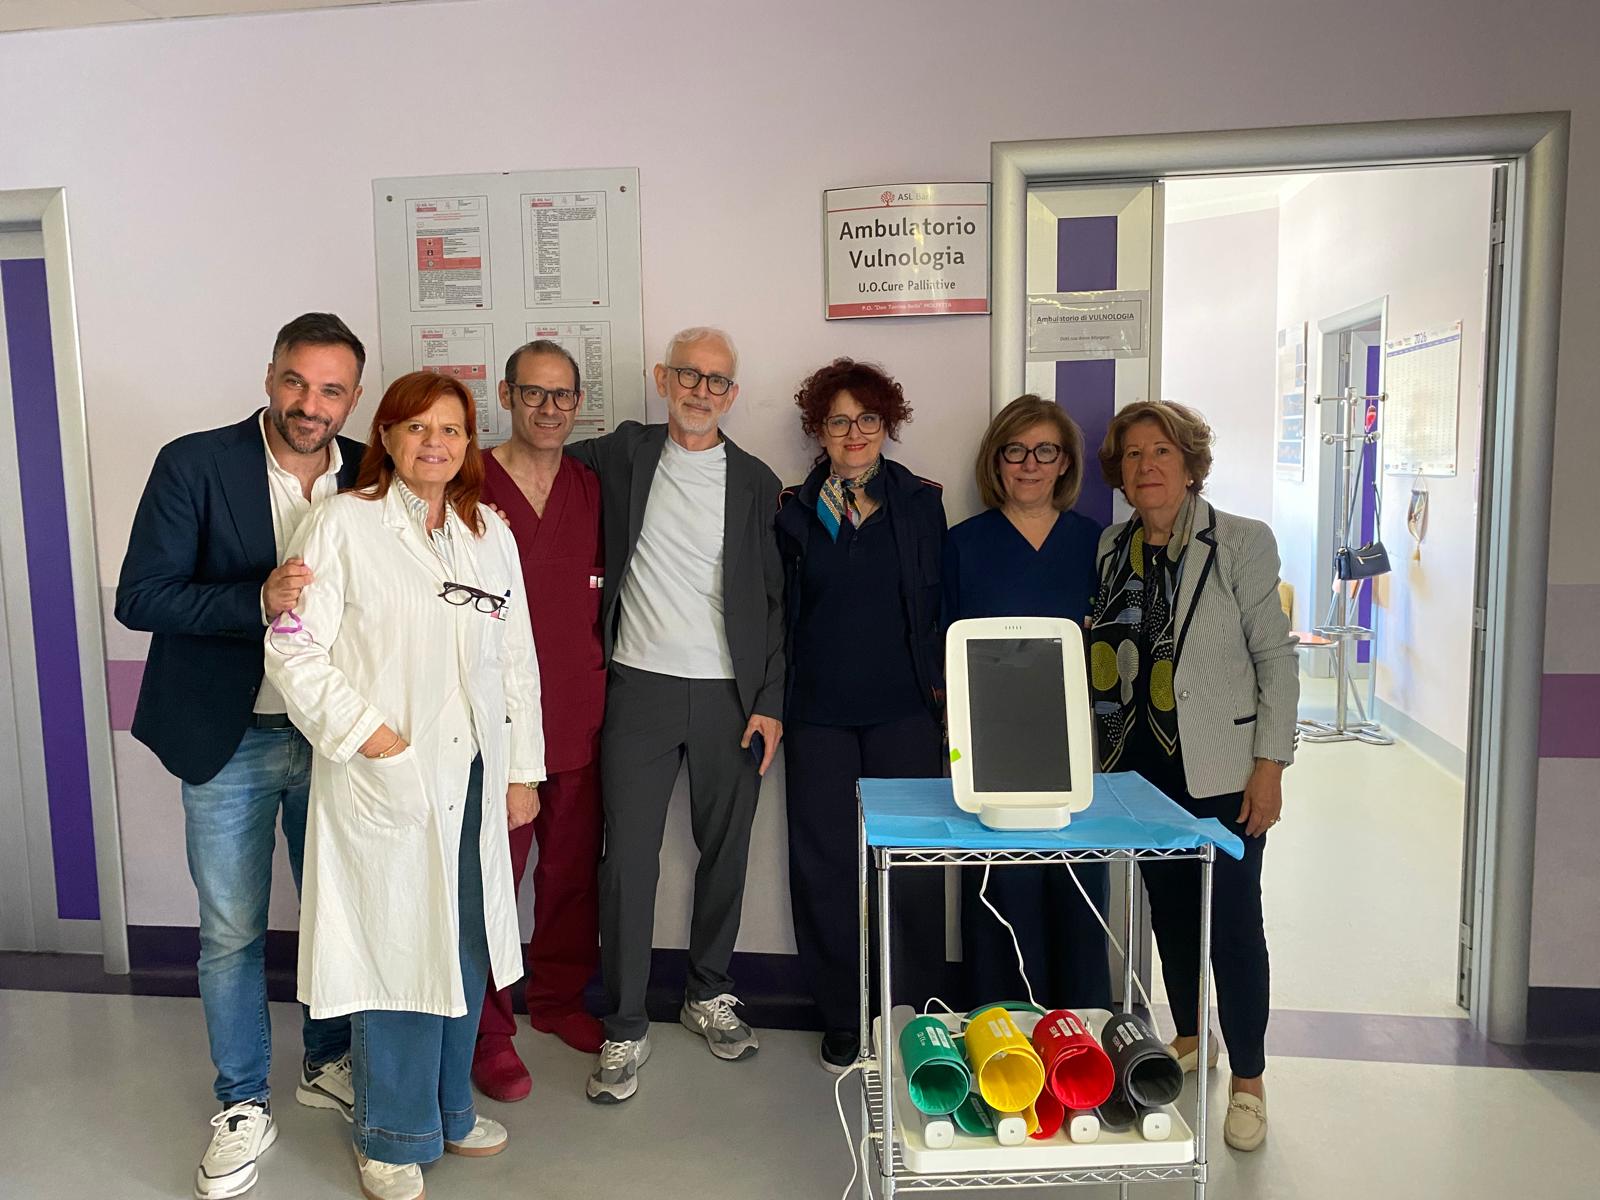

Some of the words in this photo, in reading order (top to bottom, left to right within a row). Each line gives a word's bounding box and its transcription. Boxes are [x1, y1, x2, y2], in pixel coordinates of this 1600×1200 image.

[897, 193, 913, 201] ASL
[839, 216, 976, 241] Ambulatorio
[849, 246, 965, 270] Vulnologia
[907, 279, 956, 291] Palliative
[1088, 313, 1135, 321] VULNOLOGIA
